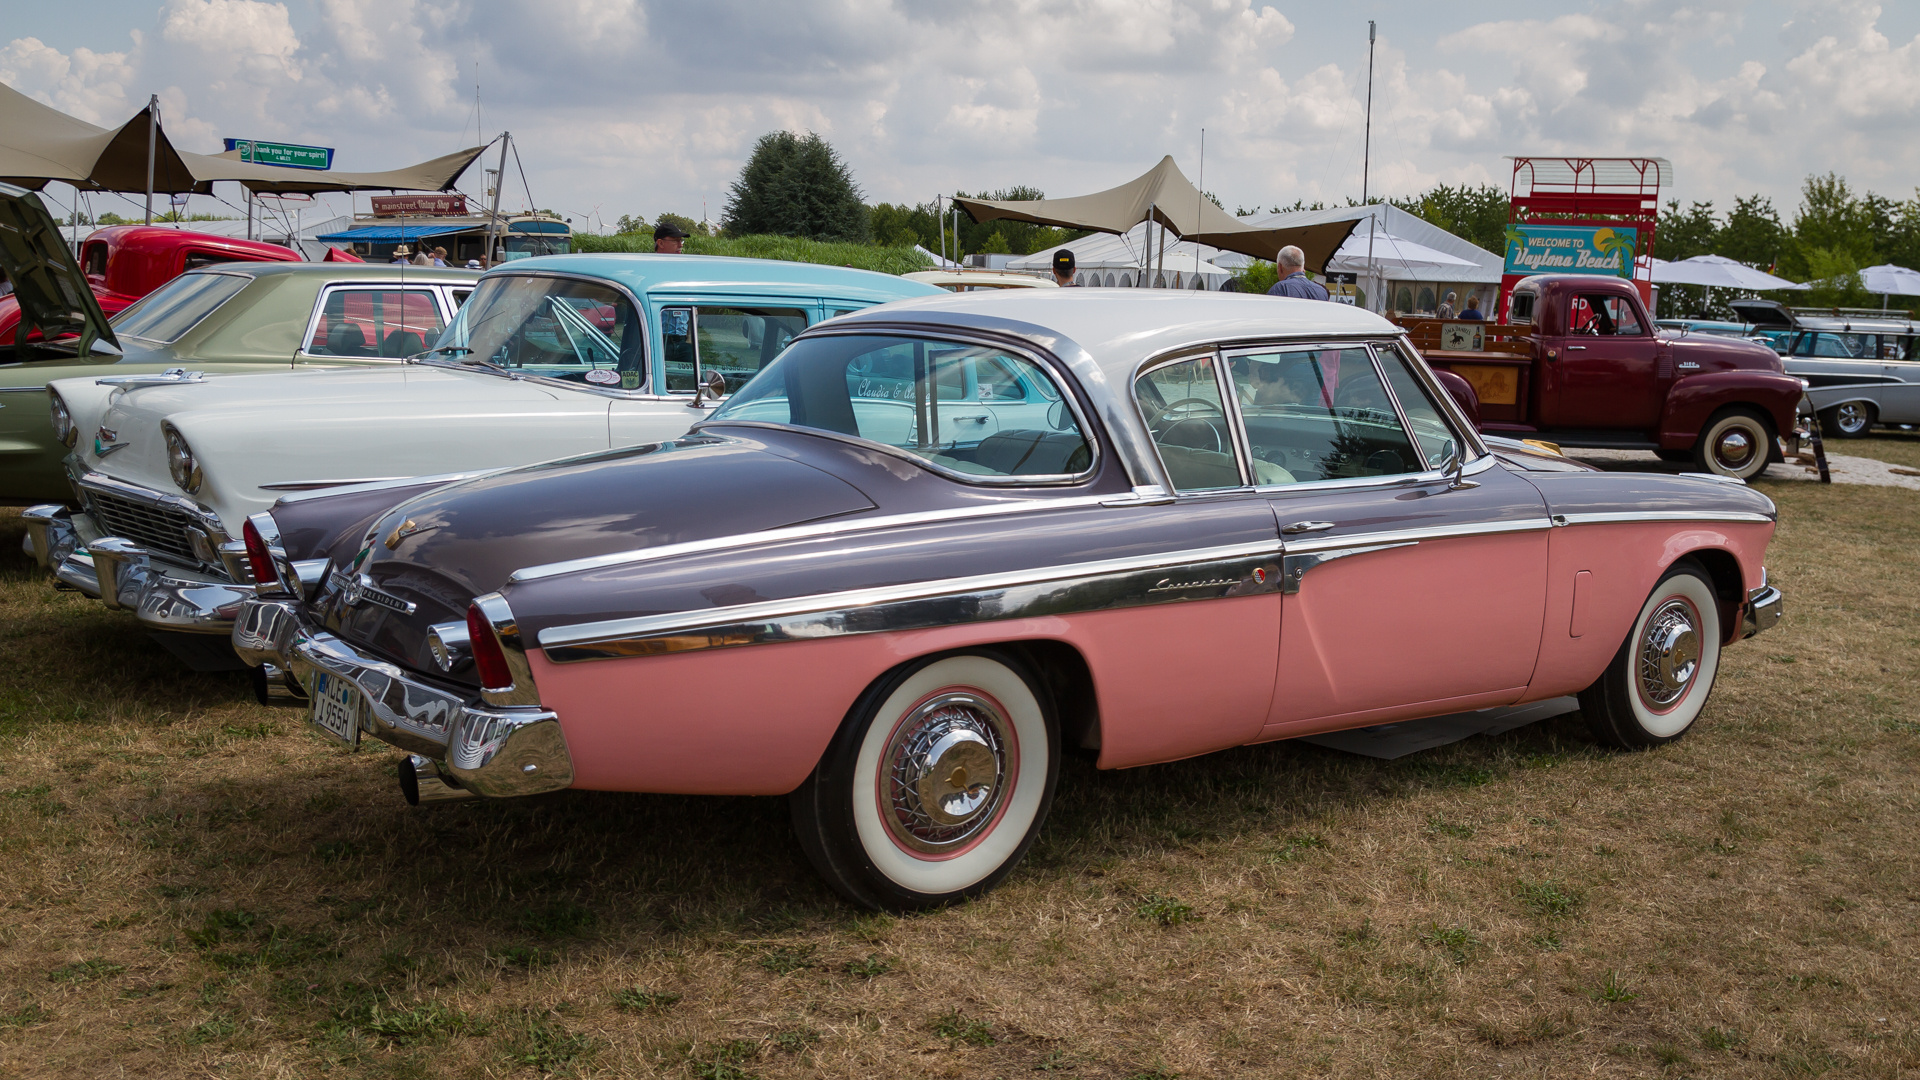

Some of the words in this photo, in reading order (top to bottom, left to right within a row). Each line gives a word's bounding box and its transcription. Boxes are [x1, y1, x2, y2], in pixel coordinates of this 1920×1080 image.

[271, 148, 282, 156] you
[283, 147, 293, 156] for
[294, 150, 308, 158] your
[308, 151, 325, 160] spirit
[381, 201, 416, 210] mainstreet
[417, 199, 436, 211] Vintage
[436, 199, 450, 211] Shop
[1528, 237, 1571, 248] WELCOME
[1573, 239, 1585, 249] TO
[1513, 247, 1574, 270] Daytona
[1575, 249, 1620, 269] Beach
[857, 378, 889, 398] Claudia
[893, 382, 902, 399] &
[362, 588, 405, 610] PRESIDENT
[325, 673, 343, 704] KLE
